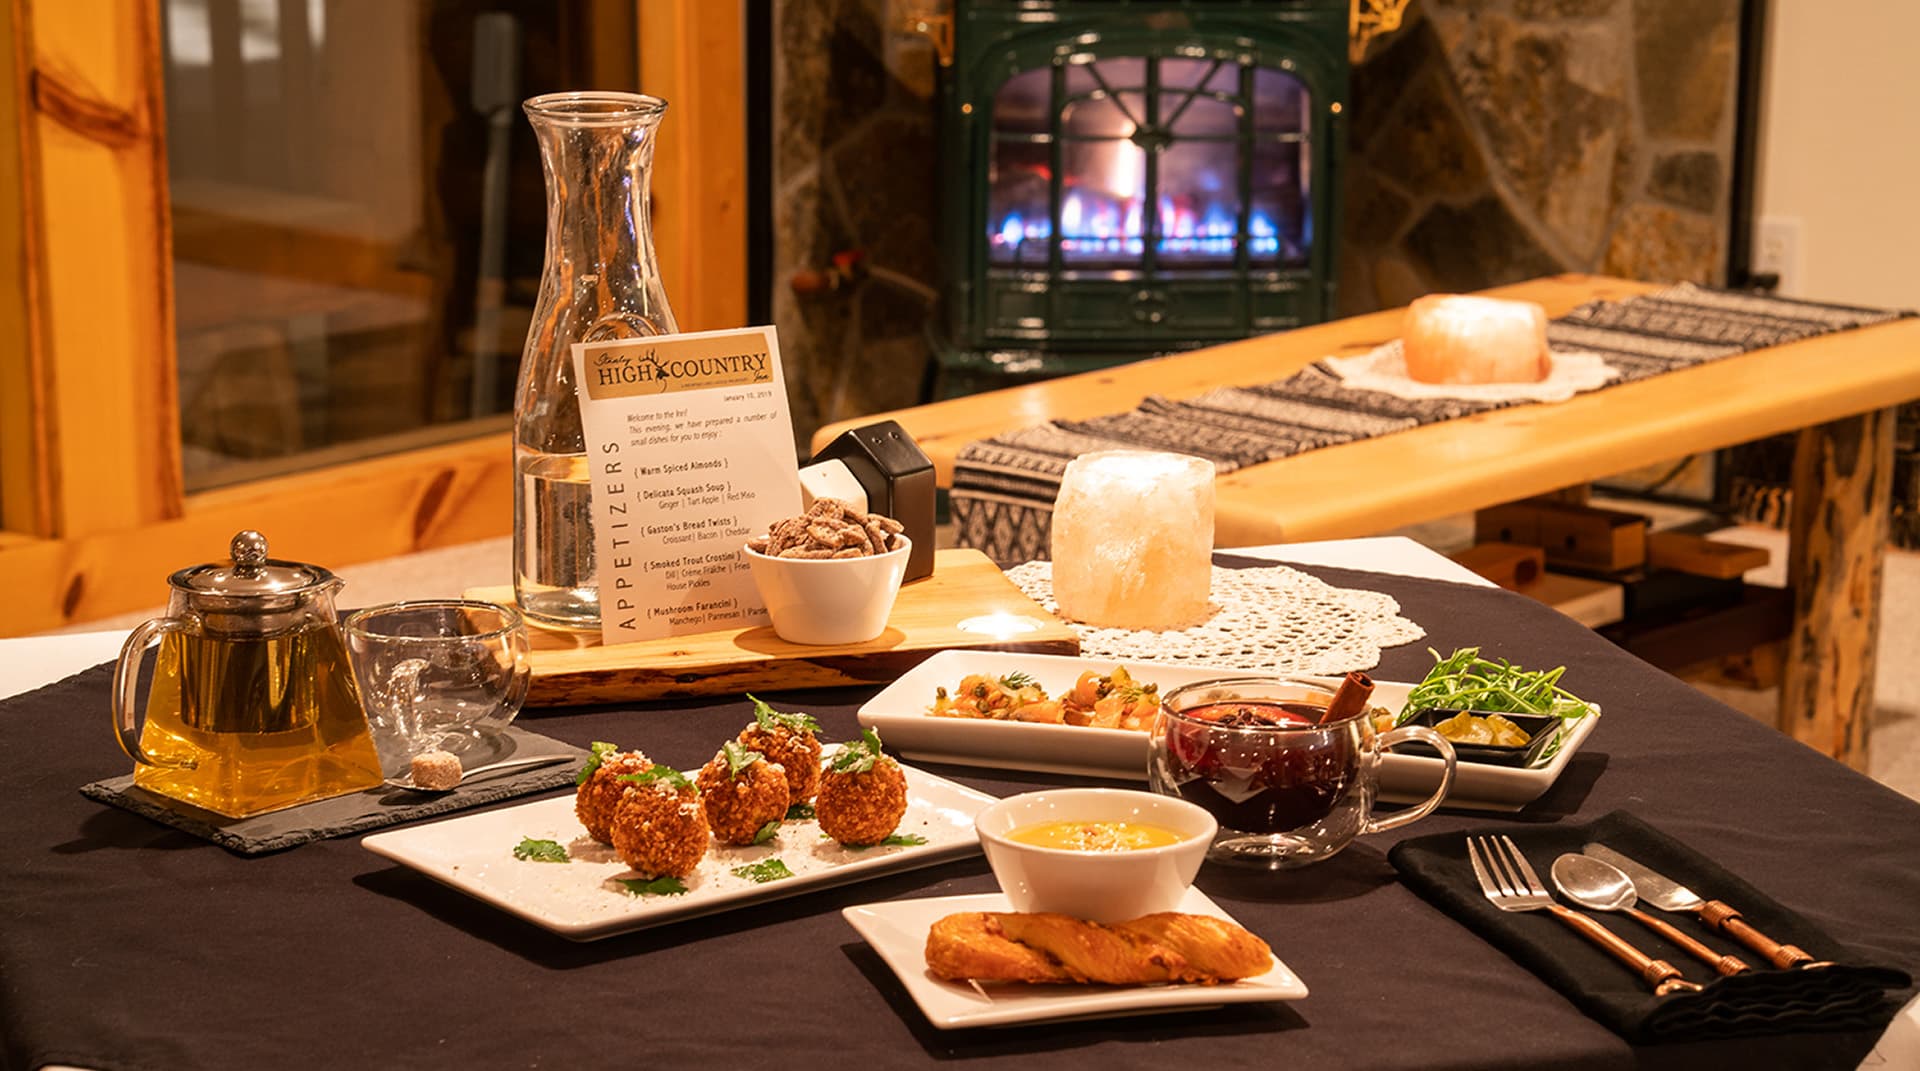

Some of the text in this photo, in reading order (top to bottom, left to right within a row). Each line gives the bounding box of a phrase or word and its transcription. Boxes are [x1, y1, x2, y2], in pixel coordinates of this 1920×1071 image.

[599, 364, 653, 386] HIGH
[670, 353, 766, 378] COUNTRY
[627, 413, 655, 422] Welcome
[655, 412, 662, 420] to
[663, 410, 674, 419] the
[629, 425, 642, 434] This
[687, 420, 702, 428] have
[704, 416, 734, 428] prepared
[743, 413, 767, 422] number
[769, 410, 777, 420] of
[648, 436, 669, 445] dishes
[670, 433, 679, 442] for
[680, 434, 693, 443] you
[701, 431, 718, 440] enjoy
[640, 467, 661, 475] Warm
[662, 463, 688, 475] Spiced
[690, 459, 722, 470] Almonds
[643, 488, 674, 500] Delicata
[676, 484, 704, 496] Squash
[705, 482, 725, 494] Soup
[658, 499, 680, 511] Ginger
[687, 496, 701, 506] Tart
[702, 495, 720, 505] Apple
[727, 491, 740, 501] Red
[741, 490, 756, 499] Miso
[647, 522, 681, 535] Gaston's
[682, 519, 706, 531] Bread
[707, 517, 732, 528] Twists
[697, 529, 719, 540] Bacon
[725, 526, 751, 537] Cheddar
[602, 442, 637, 631] APPETIZERS
[650, 557, 681, 570] Smoked
[682, 554, 704, 566] Trout
[705, 551, 736, 563] Crostini
[734, 561, 752, 570] Fried
[666, 577, 712, 591] House Pickles
[653, 603, 695, 617] Mushroom
[696, 599, 732, 611] Farancini
[707, 609, 740, 621] Parmesan
